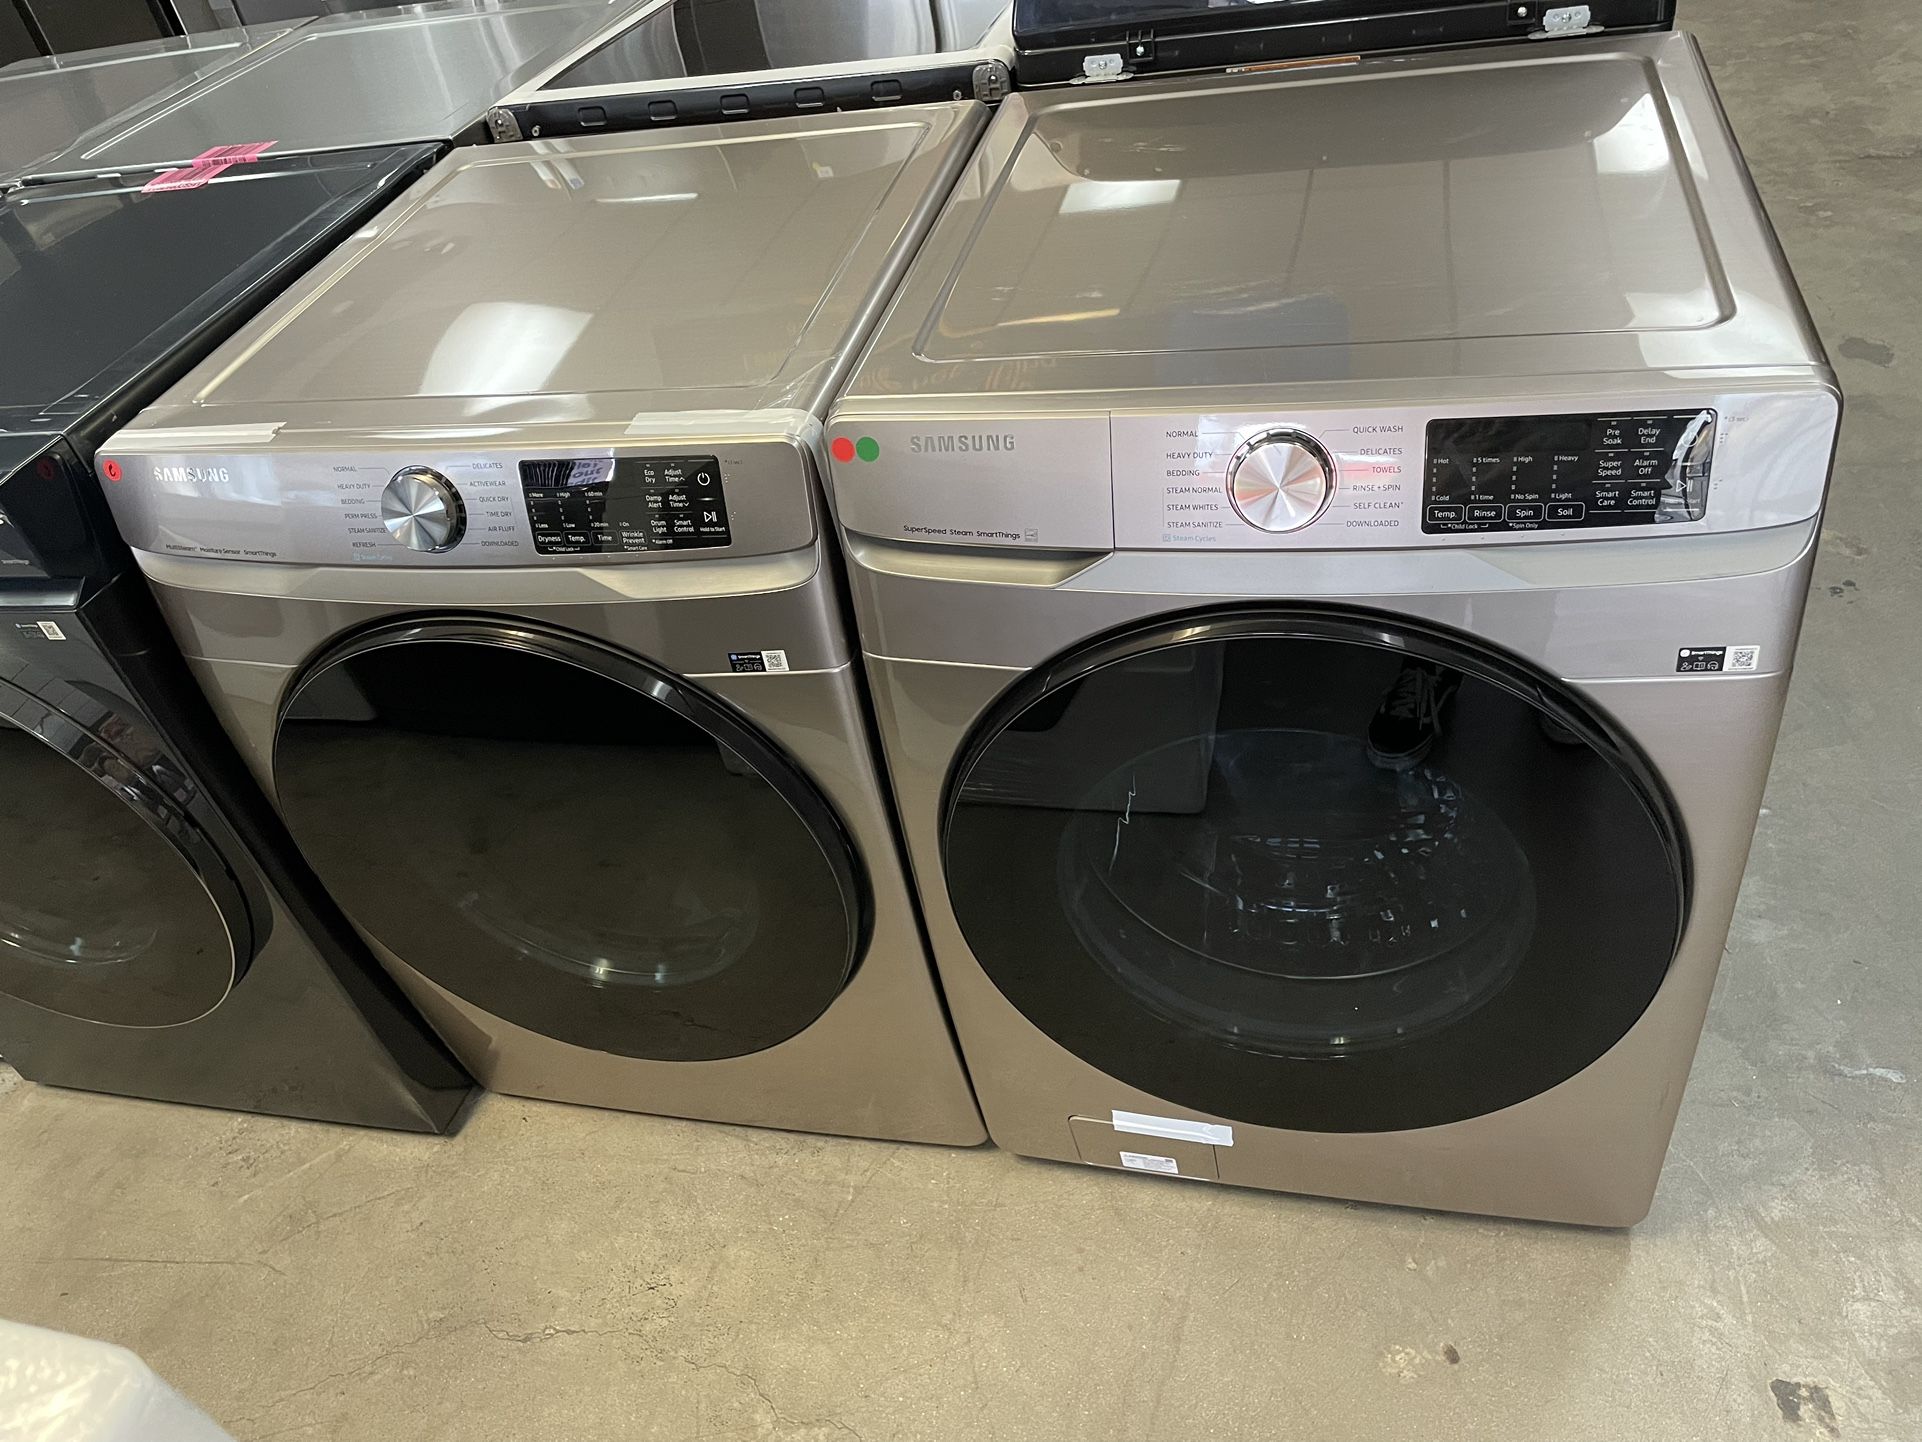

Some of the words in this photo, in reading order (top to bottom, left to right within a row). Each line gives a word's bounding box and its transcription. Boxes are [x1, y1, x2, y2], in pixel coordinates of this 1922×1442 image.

[1352, 425, 1378, 434] QUICK
[1379, 425, 1404, 433] WASH
[1606, 428, 1621, 436] Pre
[1638, 427, 1661, 437] Delay
[1166, 430, 1199, 438] NORMAL
[910, 433, 1016, 453] SAMSUNG
[1603, 437, 1623, 445] Soak
[1640, 436, 1656, 444] End
[1360, 447, 1403, 455] DELICATES
[1166, 452, 1192, 460] HEAVY
[1193, 451, 1214, 459] DUTY
[1517, 455, 1533, 464] High
[1483, 456, 1500, 464] times
[1599, 459, 1622, 469] Super
[664, 468, 683, 477] Adjust
[1166, 469, 1200, 477] BEDDING
[1372, 466, 1402, 474] TOWELS
[1597, 468, 1622, 477] Speed
[1638, 466, 1653, 475] Off
[154, 466, 229, 483] SAMSUNG
[645, 476, 656, 484] Dry
[1191, 486, 1223, 494] NORMAL
[1352, 484, 1376, 492] RINSE
[1555, 492, 1572, 501] Light
[1595, 490, 1620, 498] Smart
[1630, 489, 1655, 497] Smart
[645, 494, 662, 502] Damp
[668, 494, 687, 502] Adjust
[1597, 498, 1616, 506] Care
[1627, 498, 1656, 506] Control
[1166, 503, 1191, 511] STEAM
[1191, 503, 1219, 511] WHITES
[1353, 502, 1373, 510] SELF
[1434, 510, 1457, 519] Temp.
[1474, 509, 1496, 517] Rinse
[1515, 508, 1534, 518] Spin
[1557, 507, 1573, 516] Soil
[650, 519, 667, 527] Drum
[1167, 521, 1191, 529] STEAM
[1346, 519, 1400, 528] DOWNLOADED
[652, 526, 668, 534] Light
[903, 525, 947, 535] SuperSpeed
[949, 528, 974, 537] Steam
[976, 530, 1021, 541] SmartThings
[537, 535, 562, 543] Dryness
[568, 534, 587, 543] Temp.
